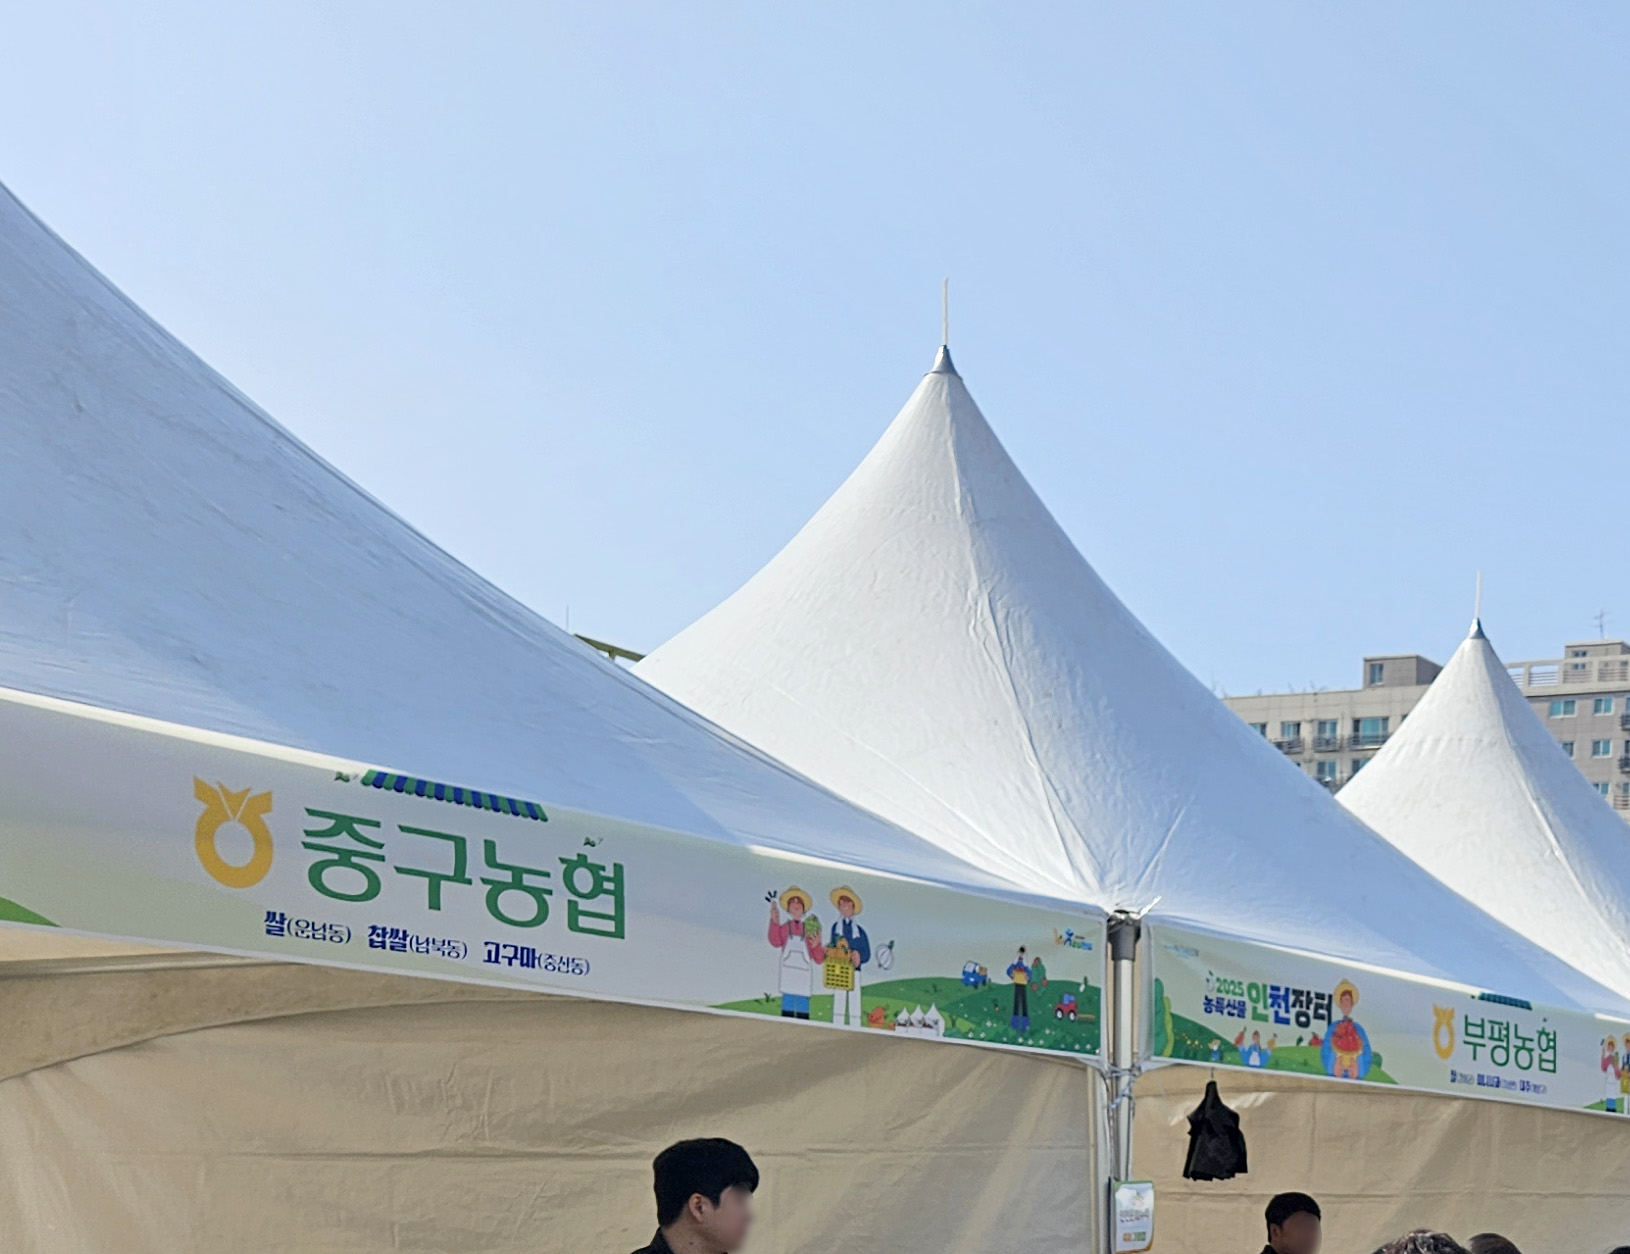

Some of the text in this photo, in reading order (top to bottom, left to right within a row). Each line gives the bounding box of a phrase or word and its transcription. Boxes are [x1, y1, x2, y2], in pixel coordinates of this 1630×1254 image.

[300, 807, 626, 940] 중구농협
[1203, 981, 1333, 1029] 농특산물 인천장터
[1216, 978, 1245, 997] 2025
[1463, 1014, 1557, 1074] 부평농협
